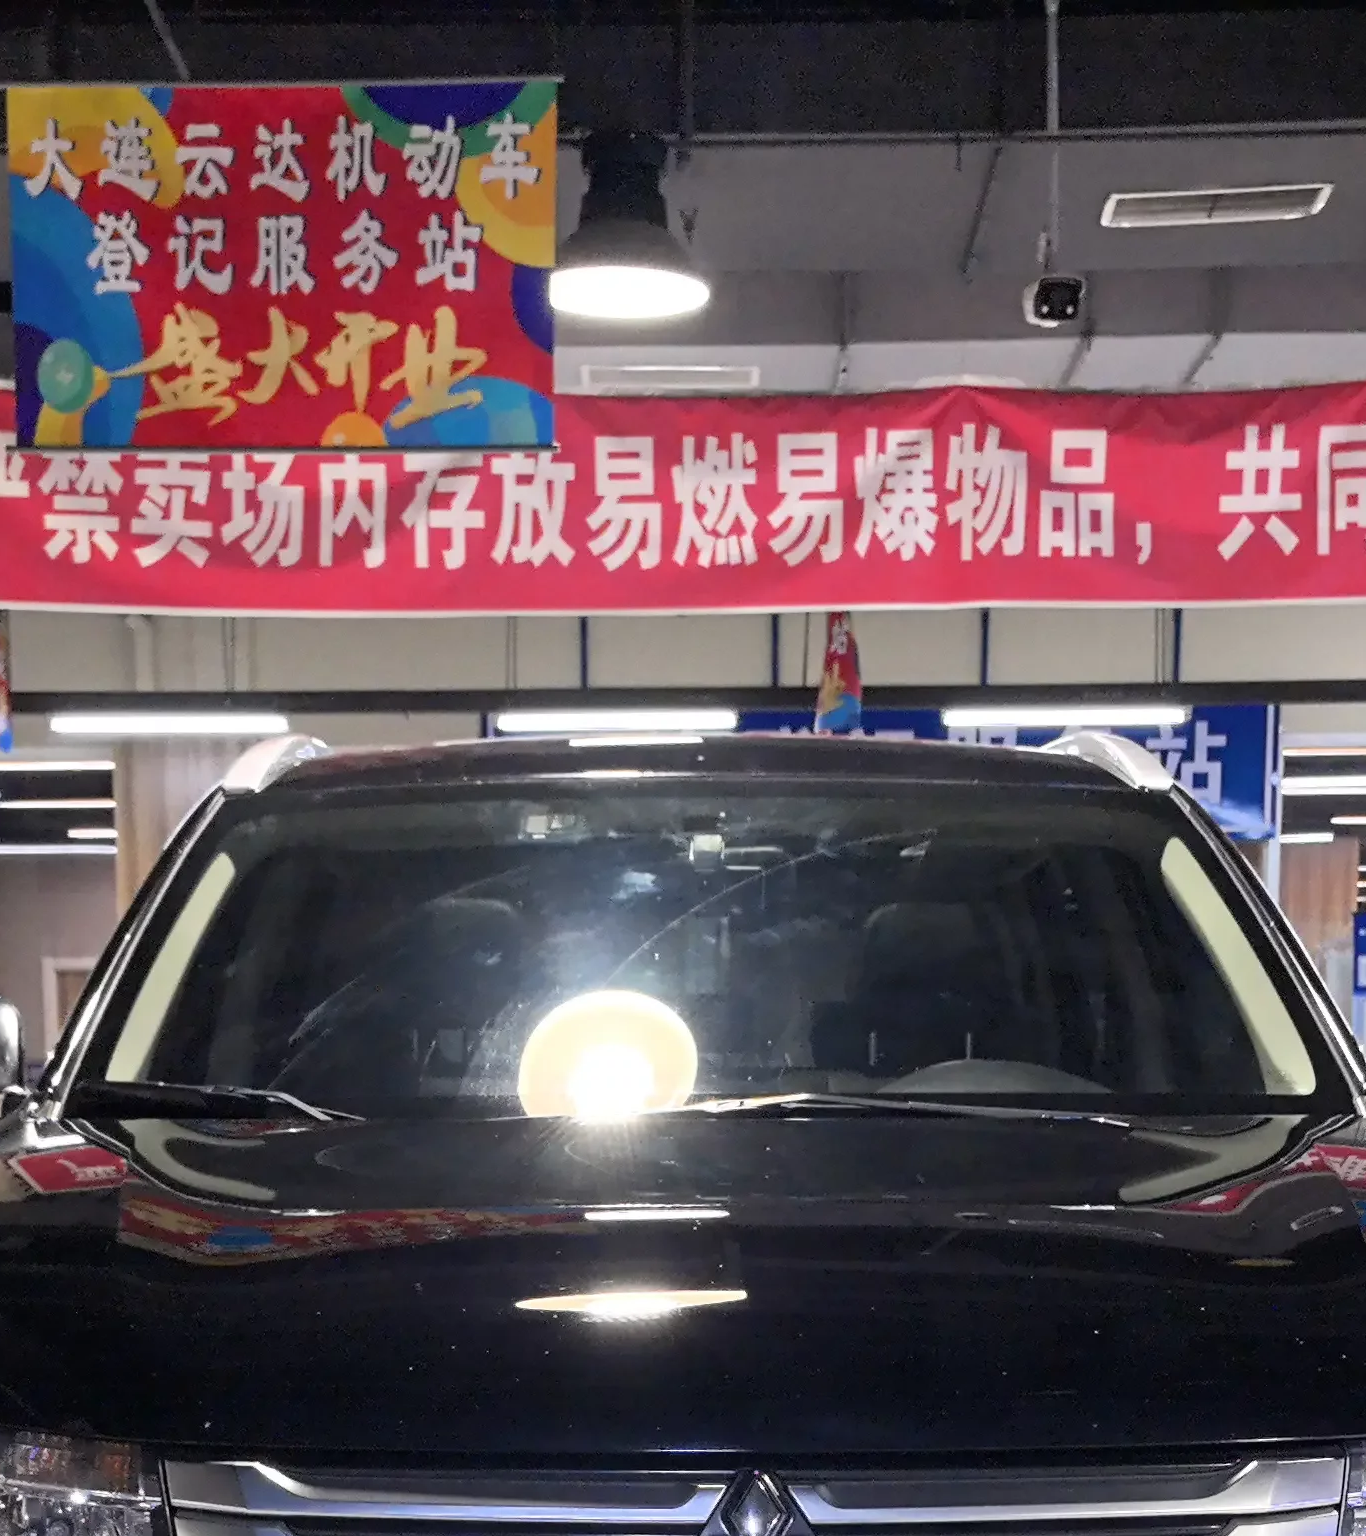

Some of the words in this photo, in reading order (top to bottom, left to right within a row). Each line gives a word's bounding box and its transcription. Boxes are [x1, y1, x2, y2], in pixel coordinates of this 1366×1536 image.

[23, 114, 542, 202] 大连云达机动车
[85, 210, 483, 296] 登记服务站
[107, 302, 488, 430] 盛大开业
